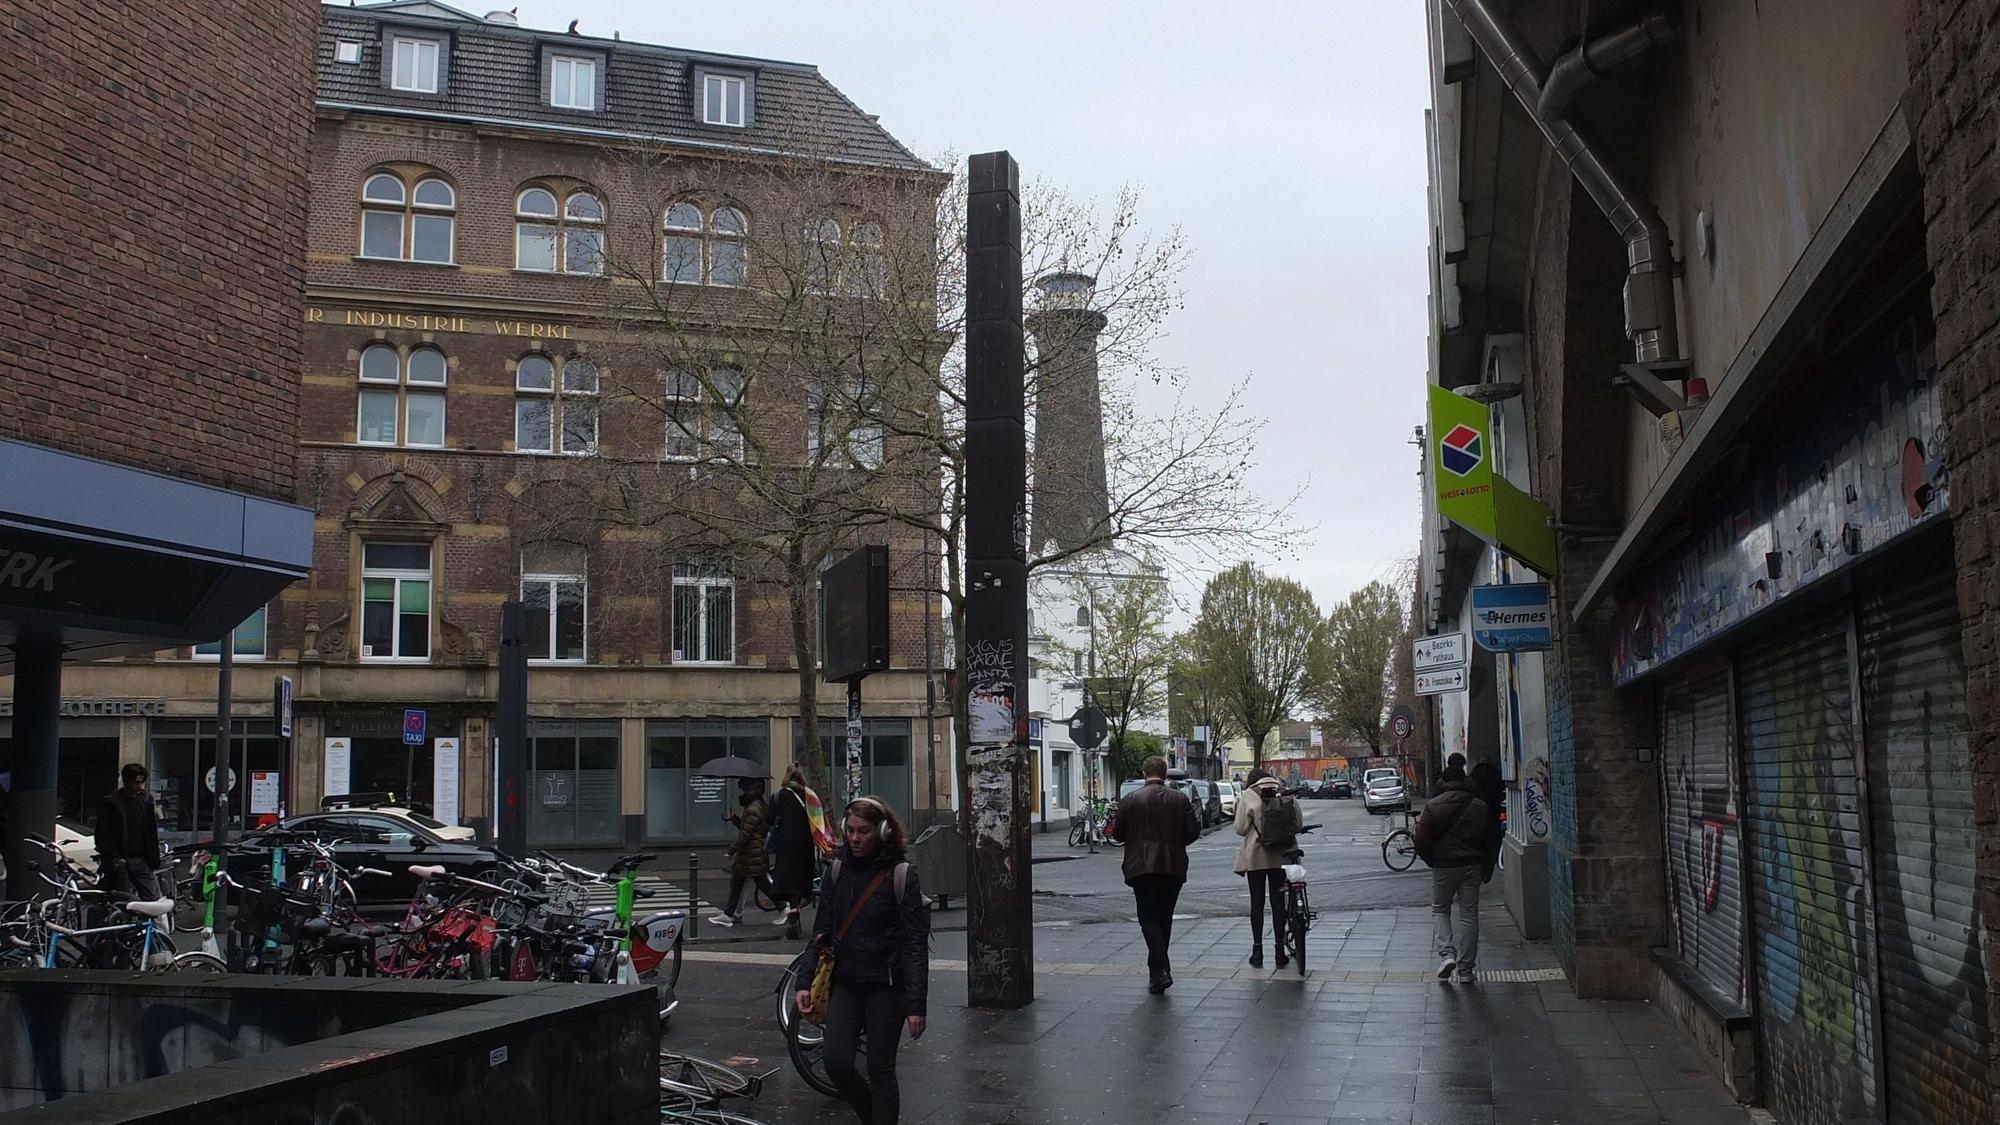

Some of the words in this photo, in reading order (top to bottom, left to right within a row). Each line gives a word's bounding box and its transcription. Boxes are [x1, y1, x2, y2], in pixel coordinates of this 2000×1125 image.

[346, 310, 471, 332] INDUSTRIE
[495, 320, 574, 339] WERKE
[1493, 611, 1546, 625] Hermes
[1432, 639, 1456, 650] Bezirks-
[1432, 653, 1454, 663] rathaus
[1396, 721, 1406, 732] 30
